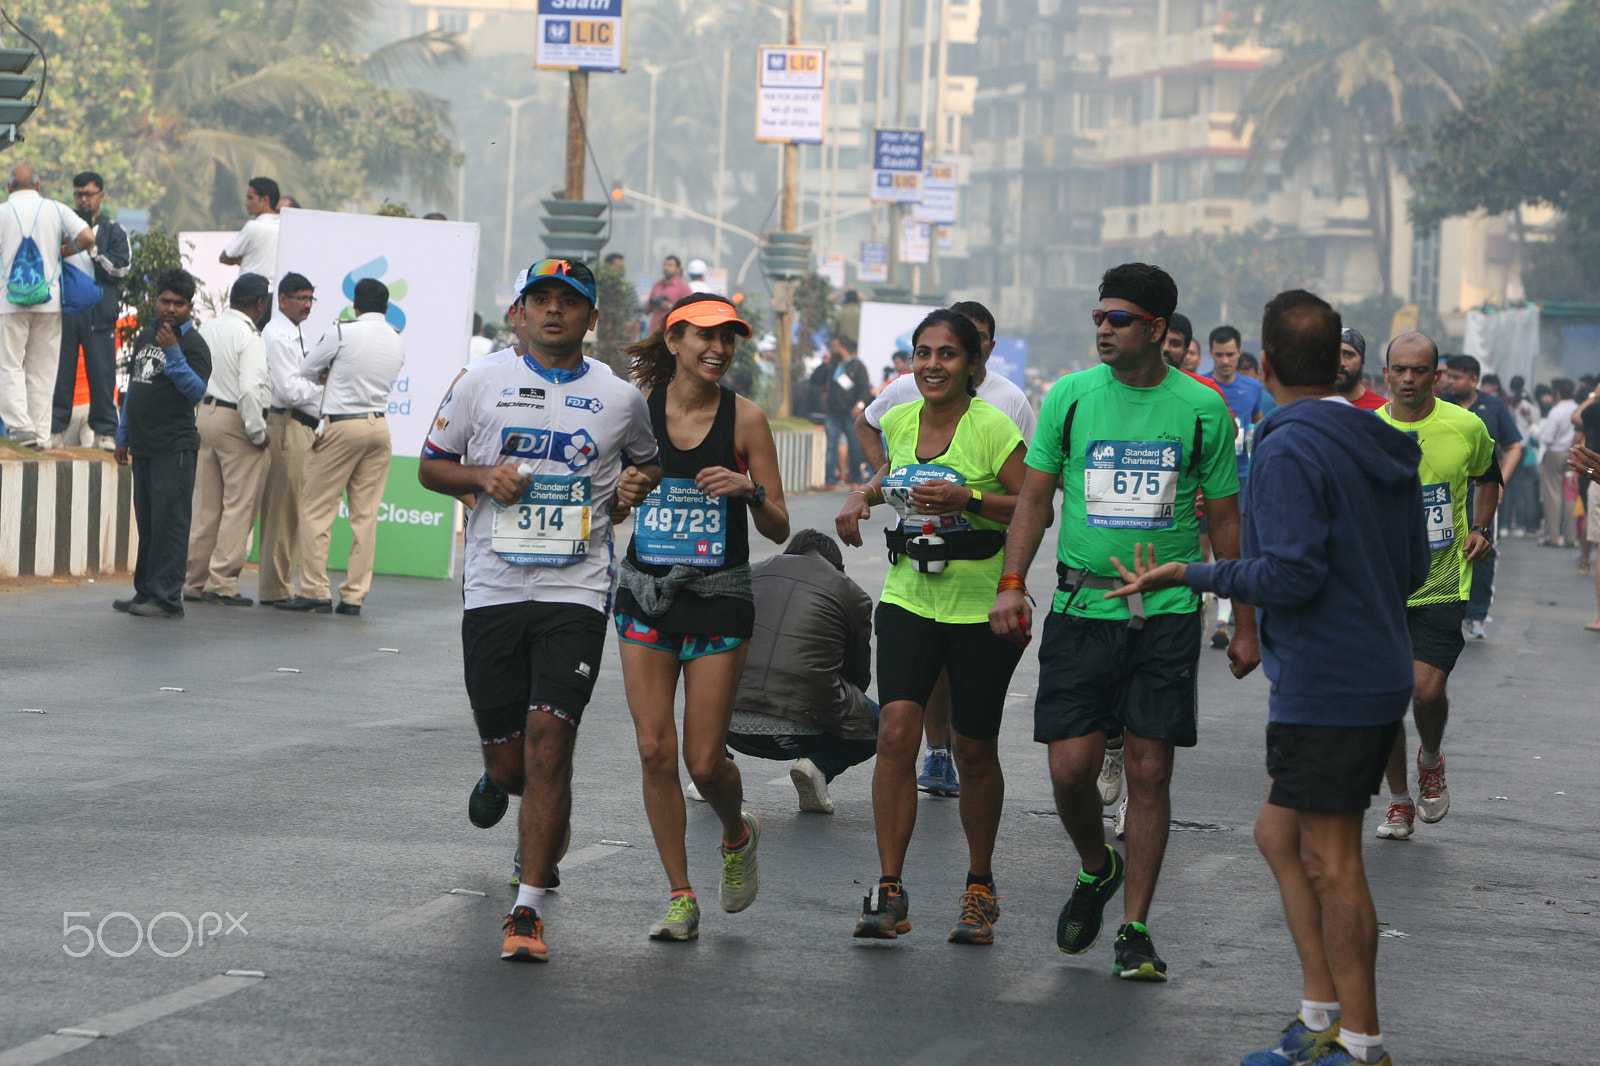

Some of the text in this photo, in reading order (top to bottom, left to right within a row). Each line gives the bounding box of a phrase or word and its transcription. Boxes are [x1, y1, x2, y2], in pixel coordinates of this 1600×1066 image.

[576, 23, 610, 43] LIC
[789, 54, 817, 71] LIC
[496, 401, 544, 410] lapierre
[566, 398, 585, 407] FDJ
[505, 433, 550, 454] FDJ
[1125, 448, 1159, 457] Standard
[1122, 457, 1159, 465] Chartered
[534, 482, 569, 491] Standard
[1114, 471, 1160, 495] 675
[670, 486, 704, 494] Standard
[530, 491, 569, 500] Chartered
[666, 494, 704, 503] Chartered
[376, 502, 443, 526] Closer
[1164, 506, 1172, 517] A
[517, 505, 564, 531] 314
[644, 507, 721, 533] 49723
[1109, 519, 1148, 527] CONSULTANCY
[1445, 529, 1452, 538] D
[576, 542, 586, 553] A
[697, 542, 723, 555] W C
